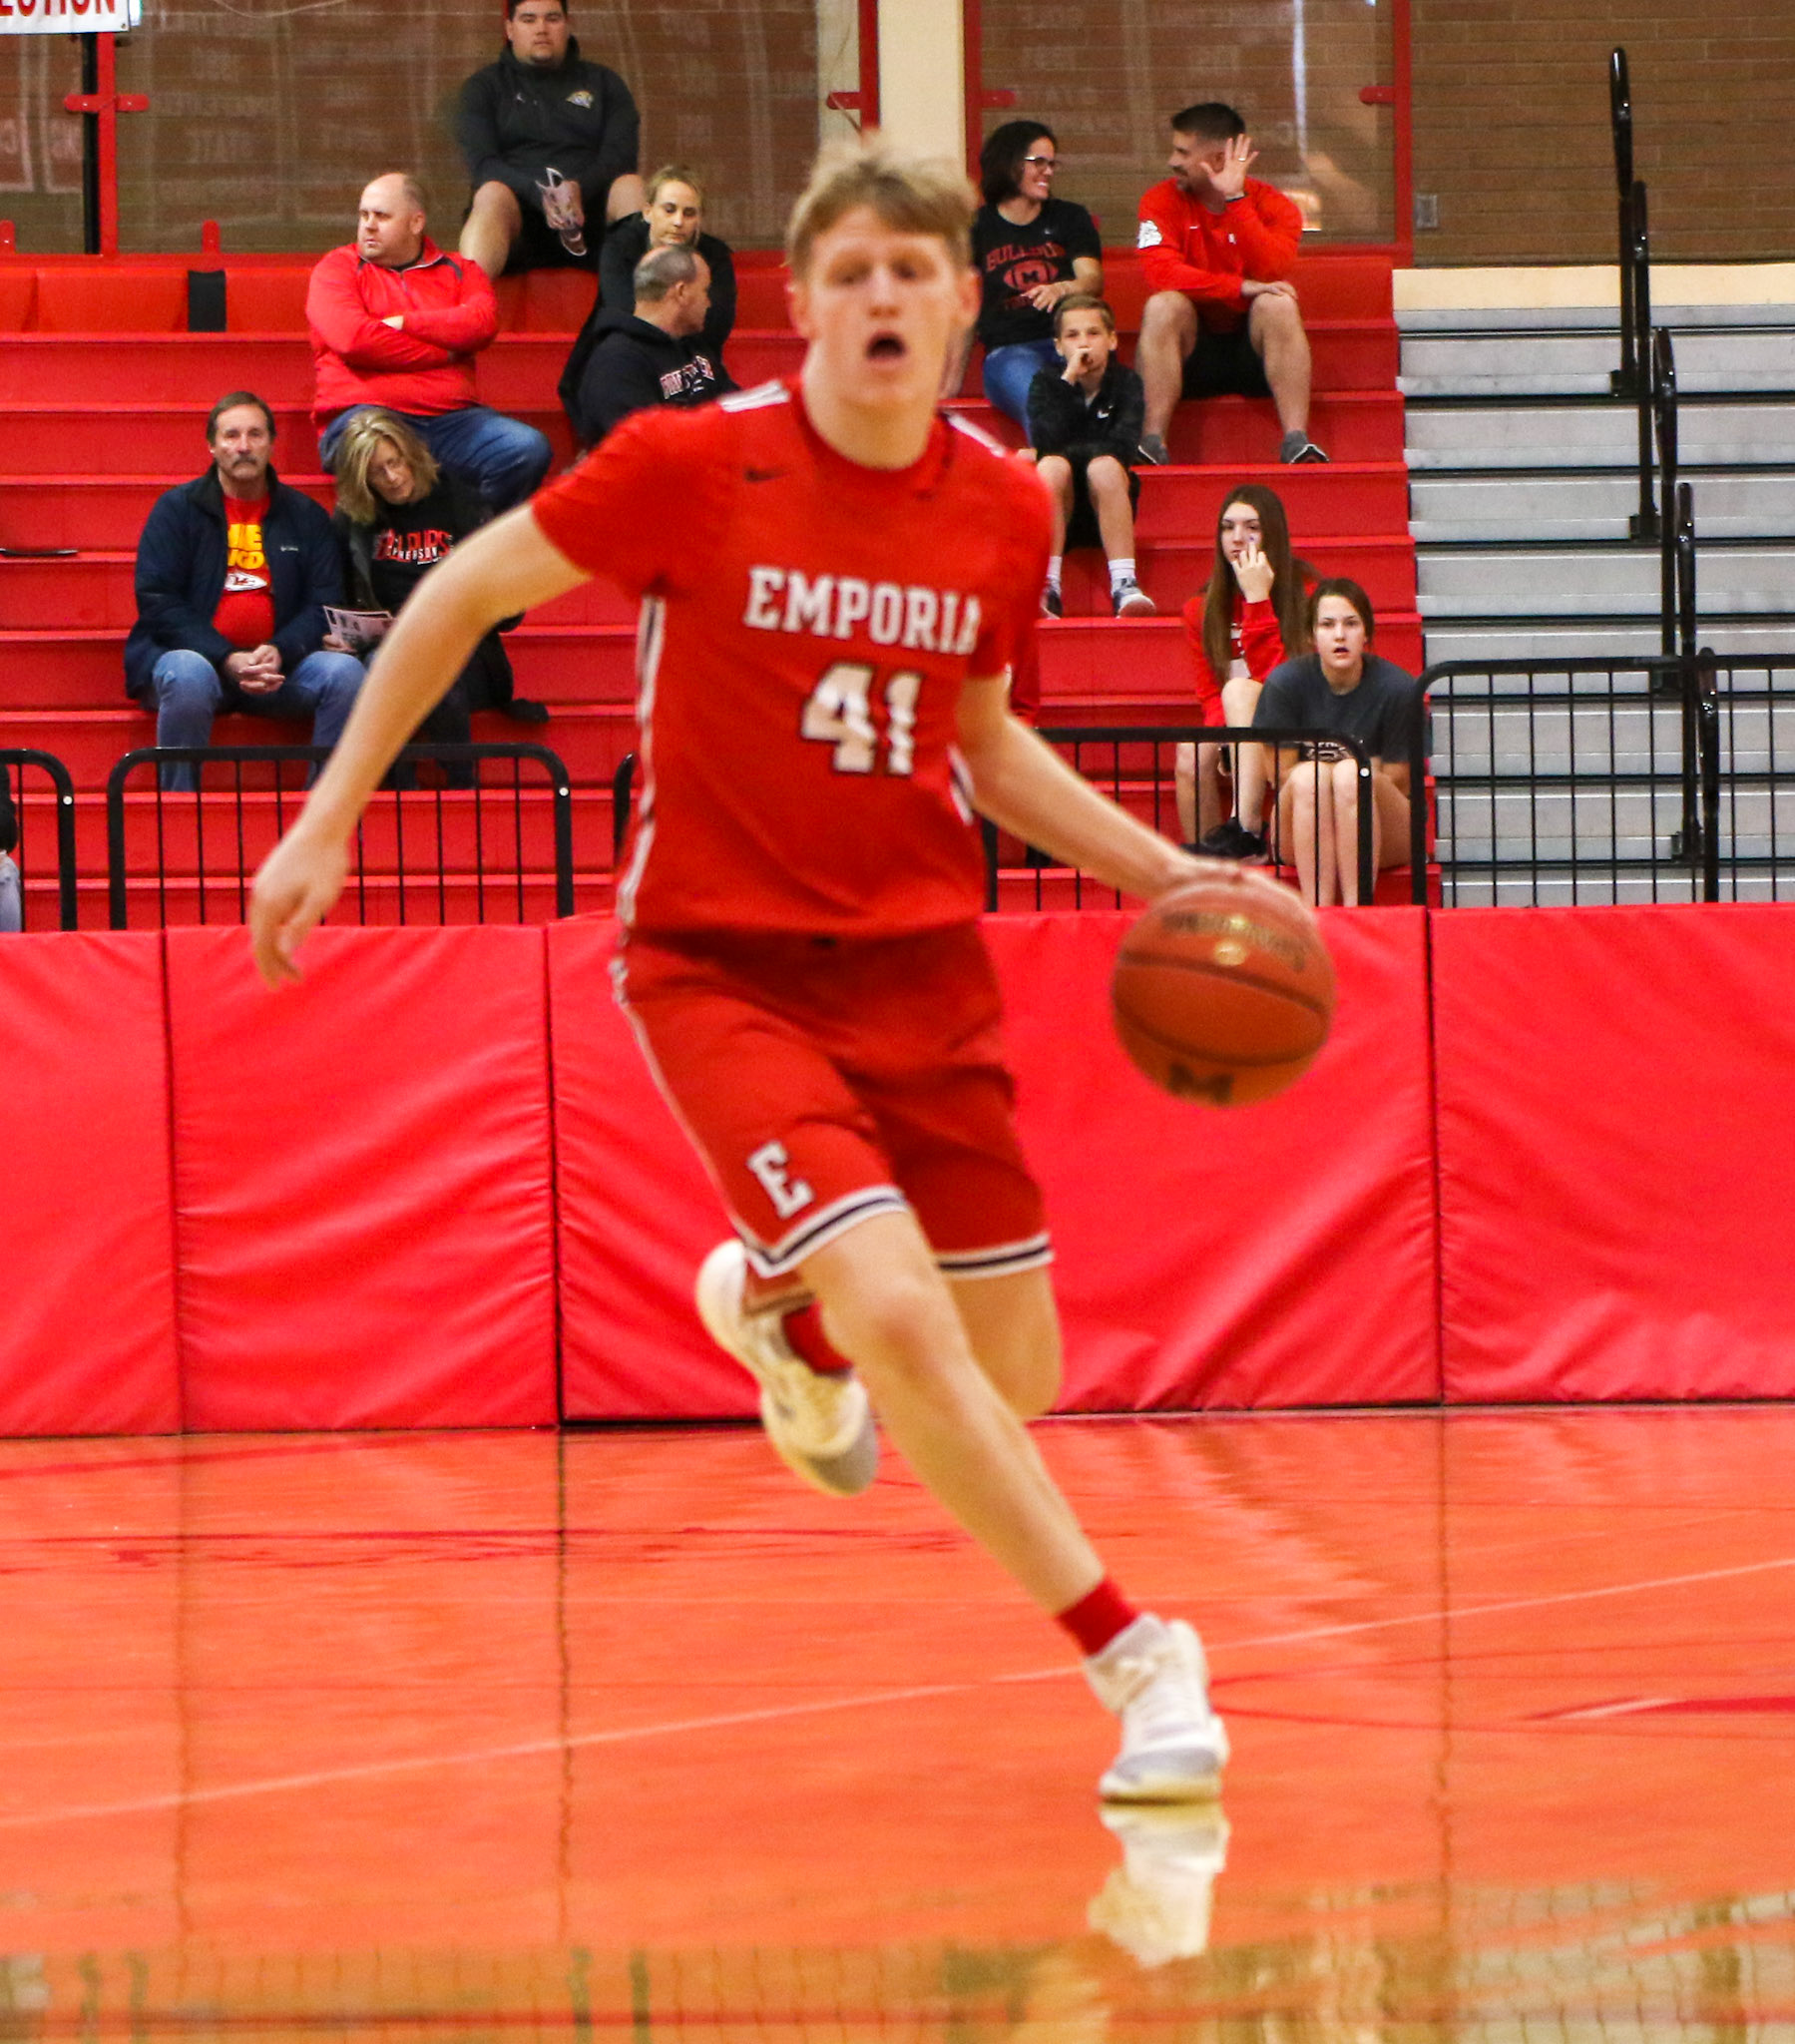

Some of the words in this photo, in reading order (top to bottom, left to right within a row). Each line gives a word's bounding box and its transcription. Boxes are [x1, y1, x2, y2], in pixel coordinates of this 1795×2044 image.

[743, 564, 982, 656] EMPORIA
[800, 662, 924, 776] 41
[746, 1140, 816, 1220] E
